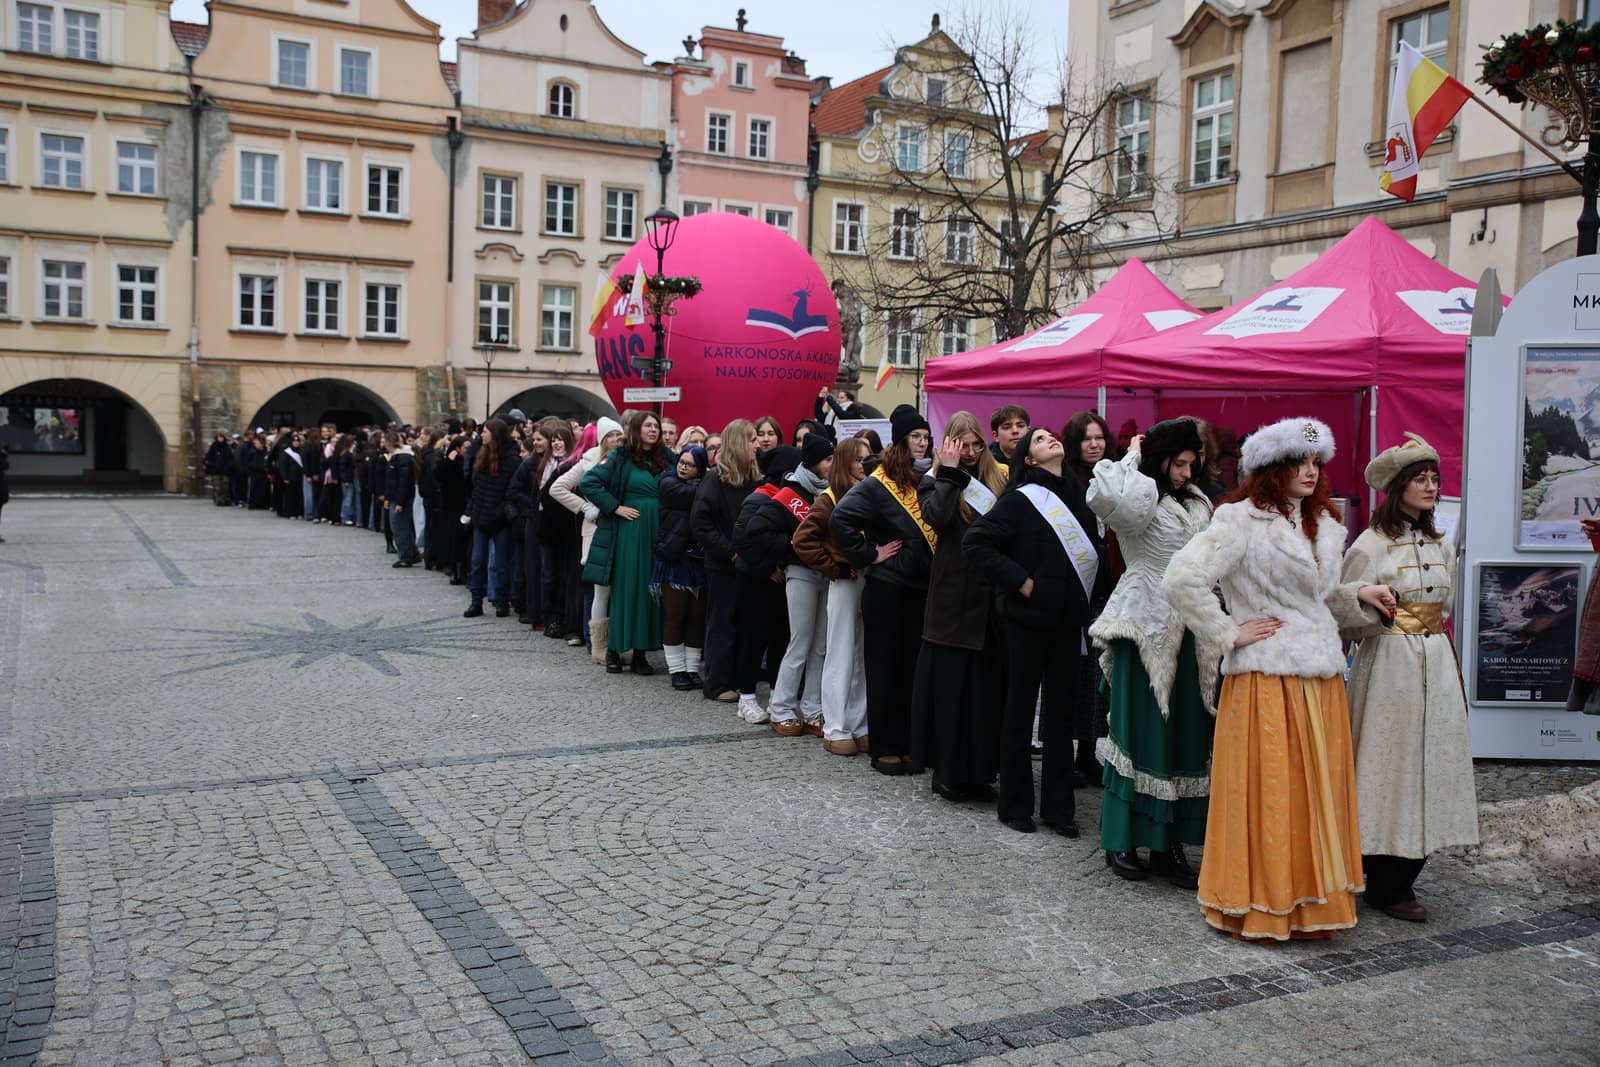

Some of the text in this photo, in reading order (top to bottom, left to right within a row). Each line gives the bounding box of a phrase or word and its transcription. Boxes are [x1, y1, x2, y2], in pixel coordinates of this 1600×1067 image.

[1573, 295, 1600, 309] MK
[703, 346, 802, 360] KARKONOSKA
[715, 366, 757, 378] NAUK
[1483, 656, 1569, 665] KAROL NIENARTOWICZ
[1540, 729, 1556, 737] MK
